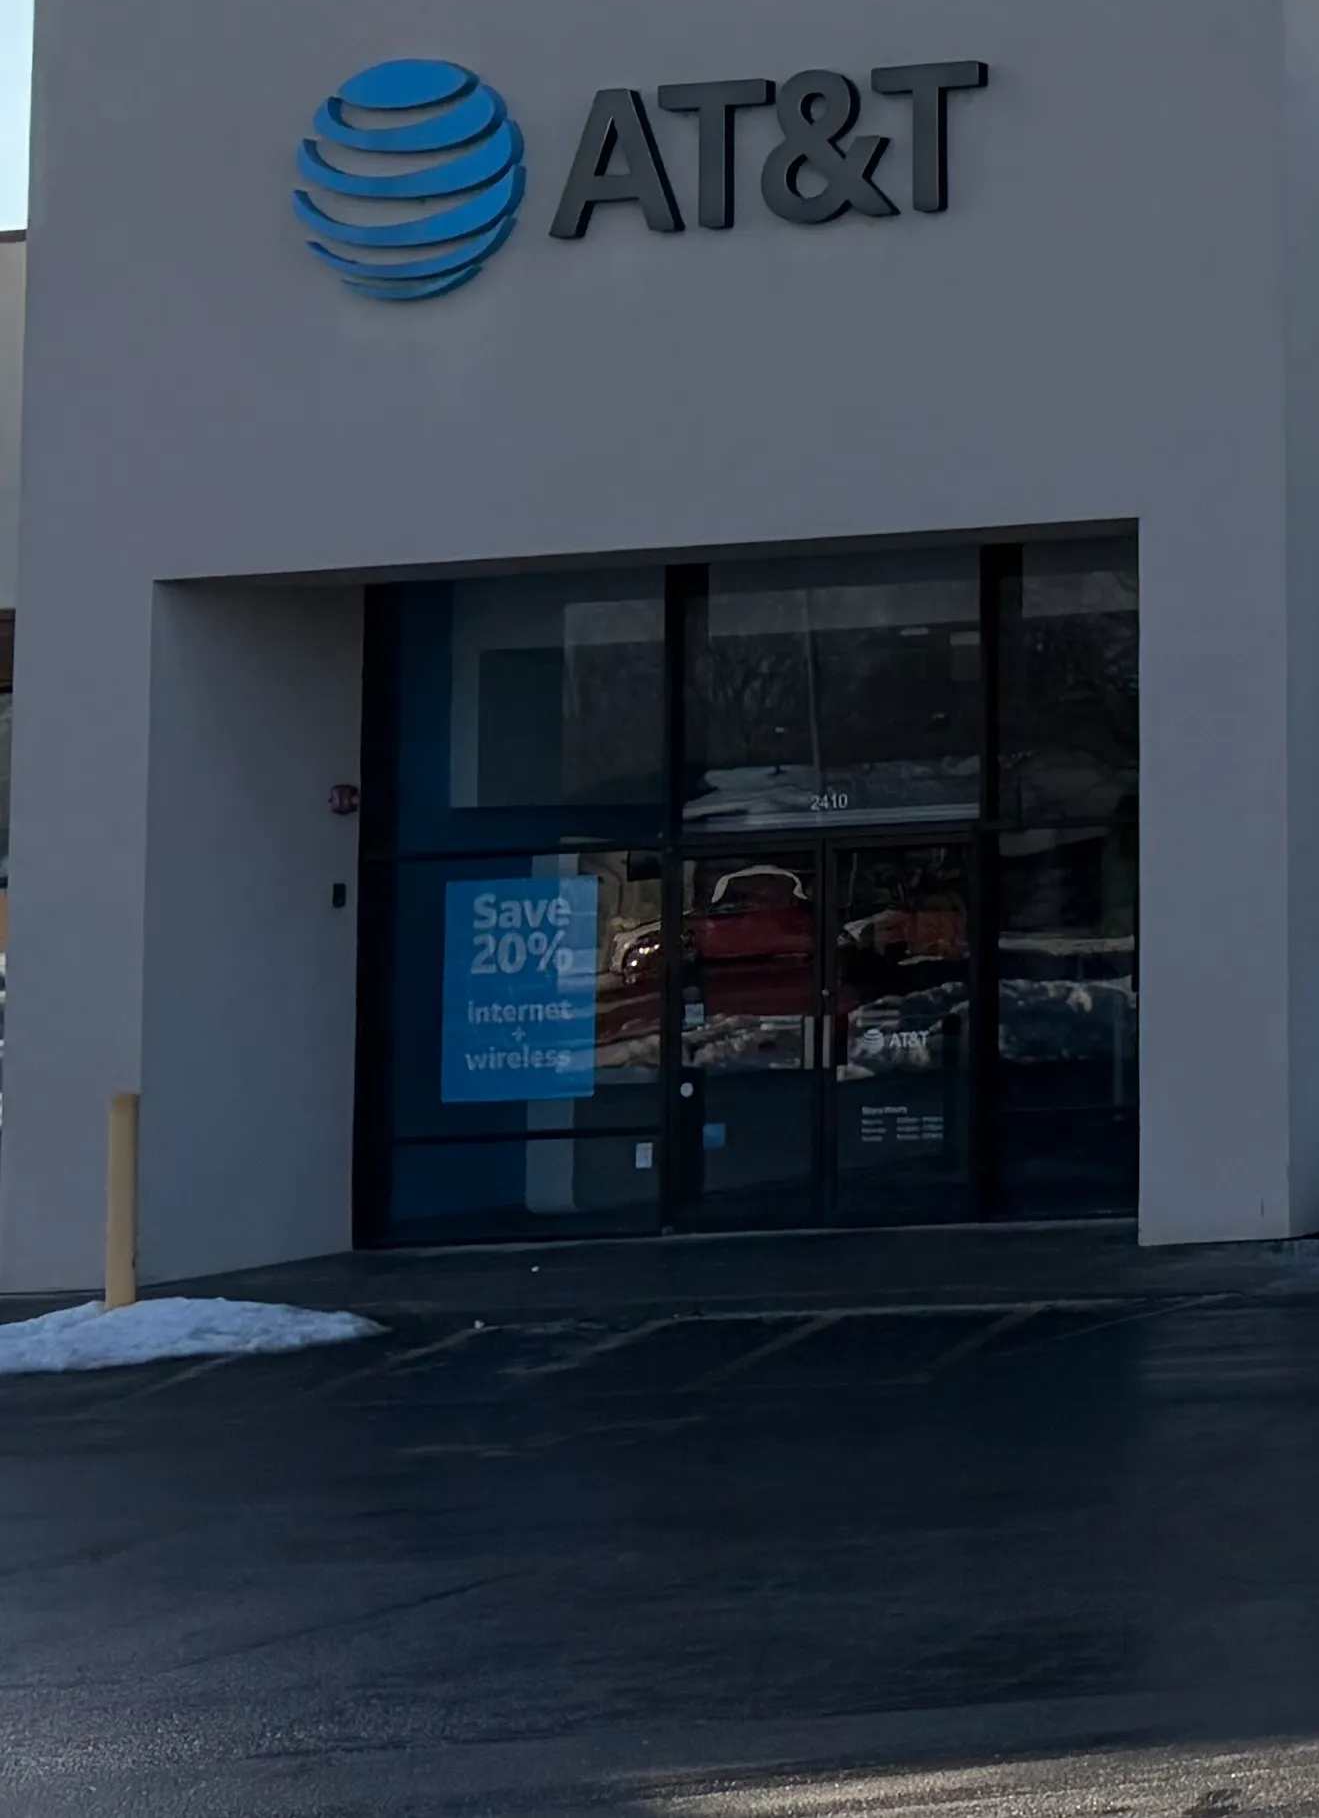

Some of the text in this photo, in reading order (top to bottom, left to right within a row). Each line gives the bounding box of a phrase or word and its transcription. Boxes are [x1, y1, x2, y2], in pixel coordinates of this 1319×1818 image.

[550, 60, 989, 239] AT&T
[810, 792, 848, 811] 2410
[473, 893, 572, 929] Save
[470, 930, 575, 974] 20%
[467, 999, 573, 1025] internet
[889, 1030, 929, 1049] AT&T
[464, 1044, 571, 1071] wireless
